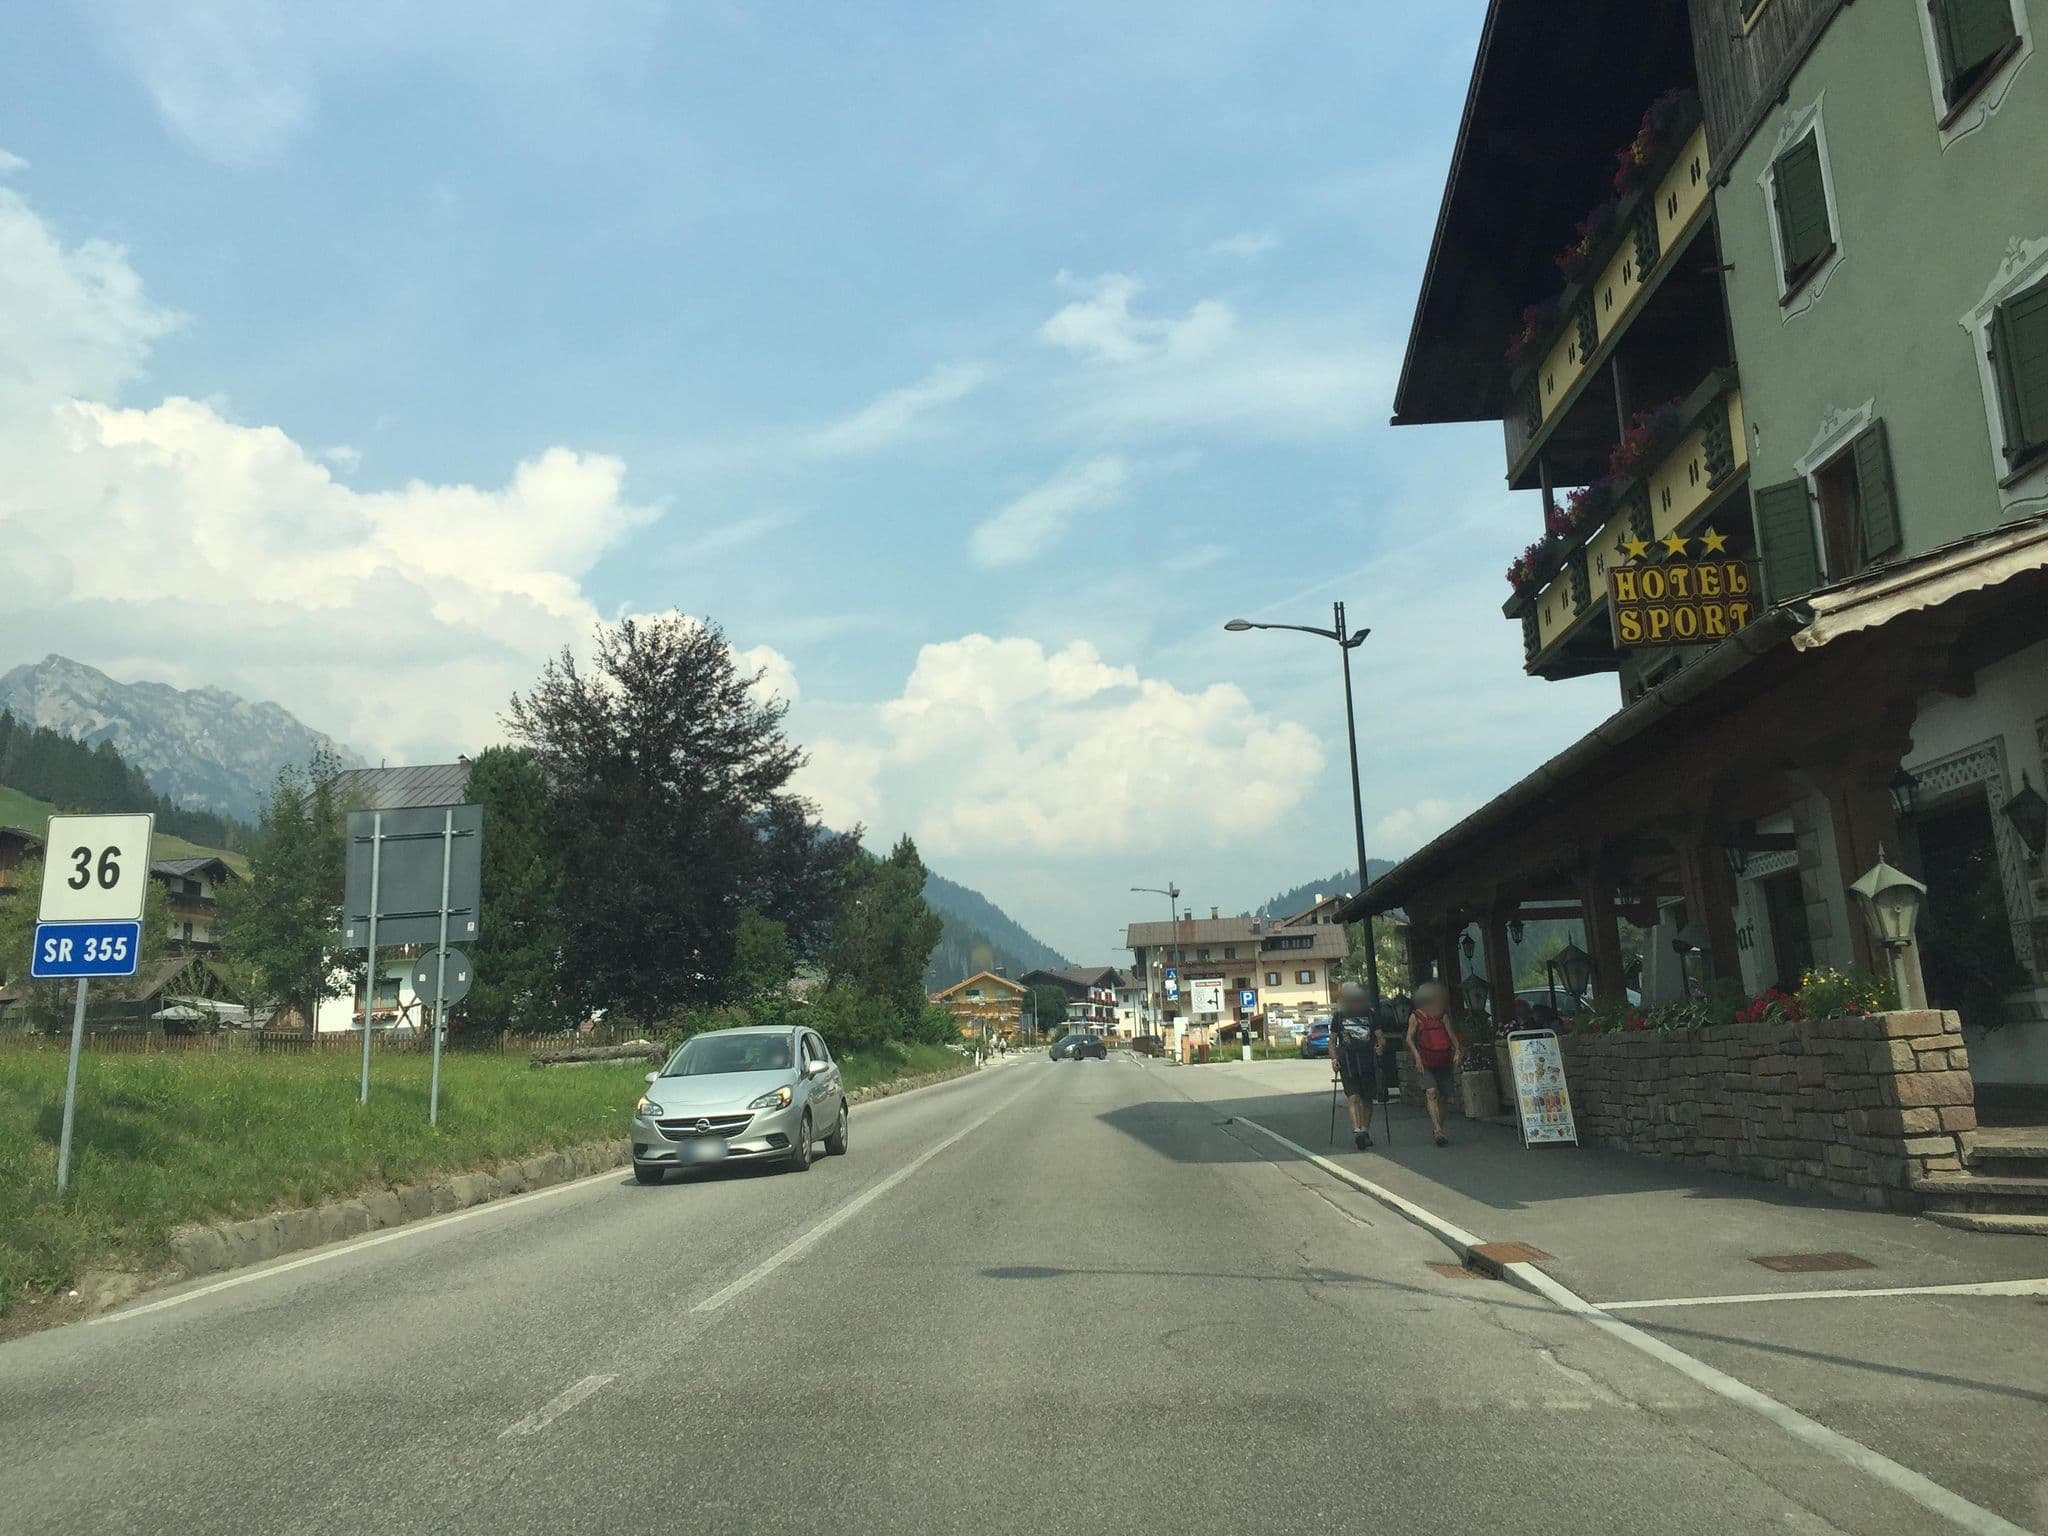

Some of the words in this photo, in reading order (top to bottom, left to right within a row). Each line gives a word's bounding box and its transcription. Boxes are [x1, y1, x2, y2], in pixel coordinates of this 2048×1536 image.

[1615, 564, 1748, 602] HOTEL
[1619, 602, 1749, 641] SPORT
[67, 845, 121, 891] 36
[43, 937, 73, 963] SR
[84, 936, 127, 962] 355
[1243, 992, 1253, 1005] P
